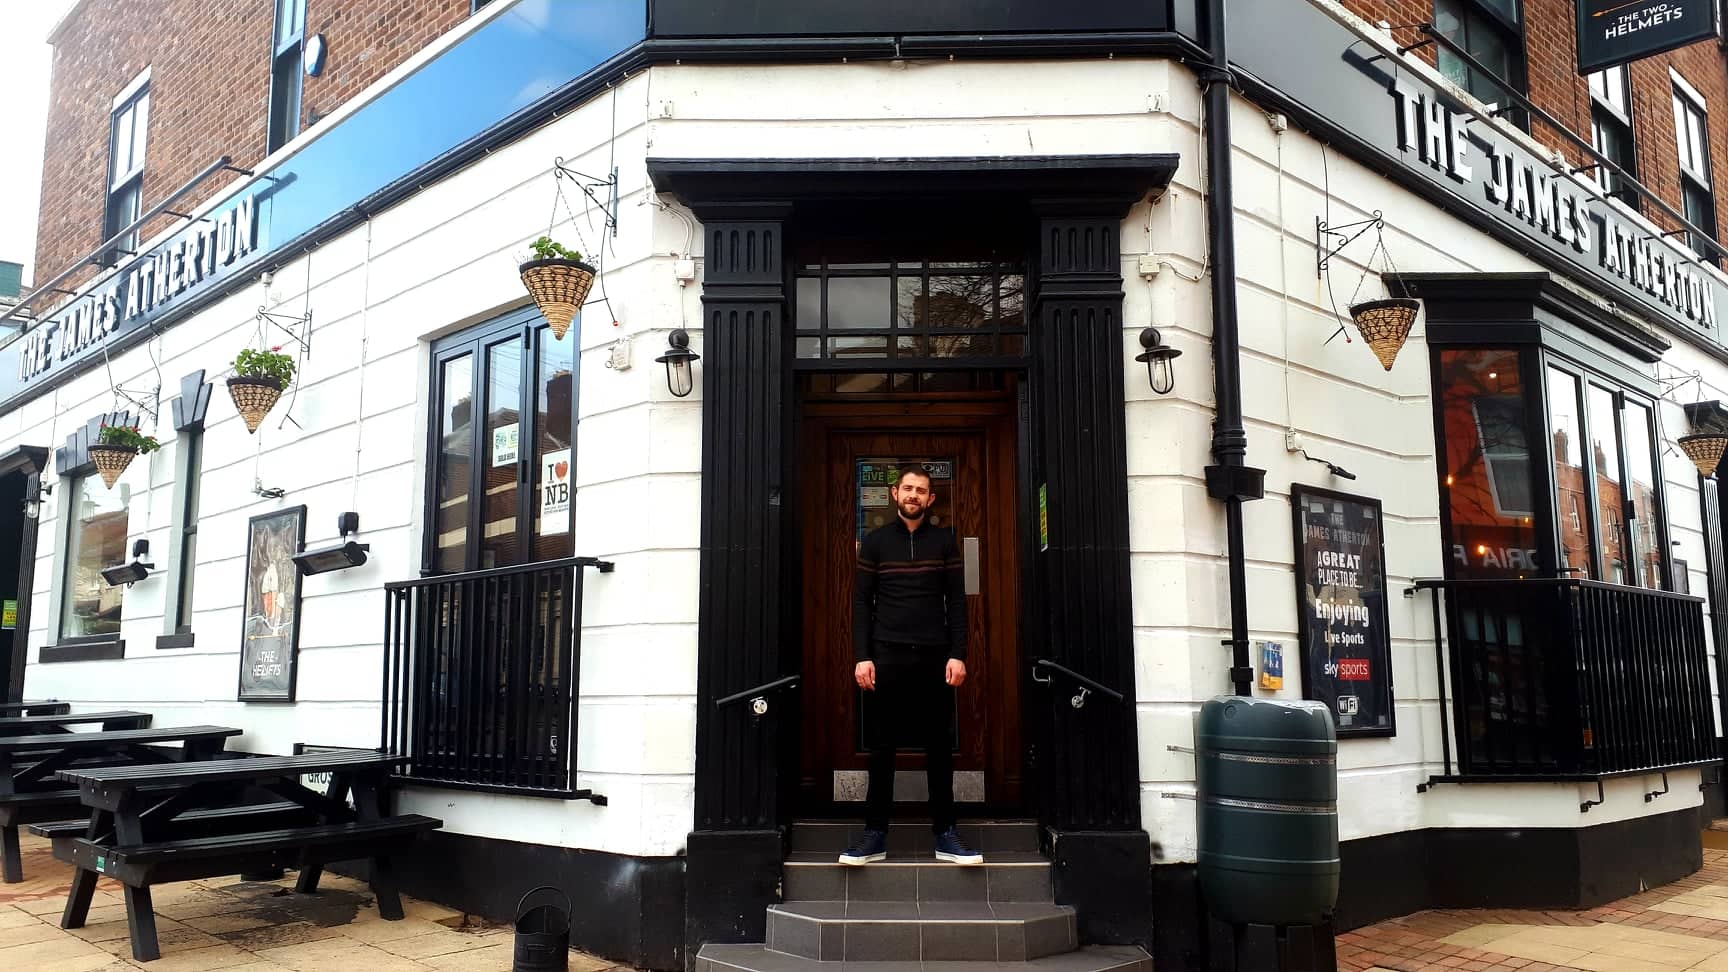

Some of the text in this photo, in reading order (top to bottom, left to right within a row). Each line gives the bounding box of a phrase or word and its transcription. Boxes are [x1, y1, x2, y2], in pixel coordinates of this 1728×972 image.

[1605, 7, 1683, 40] HELMETS
[1618, 3, 1667, 24] THE TWO
[1395, 74, 1717, 329] THE JAMES ATHERTON
[18, 193, 256, 383] THE JAMES ATHERTON
[545, 483, 568, 506] NB
[1322, 551, 1361, 569] GREAT
[1318, 568, 1339, 586] PLACE
[1340, 571, 1349, 587] TO
[1315, 598, 1369, 627] Enjoying
[1341, 631, 1364, 647] Sports
[1324, 661, 1368, 678] sky sports
